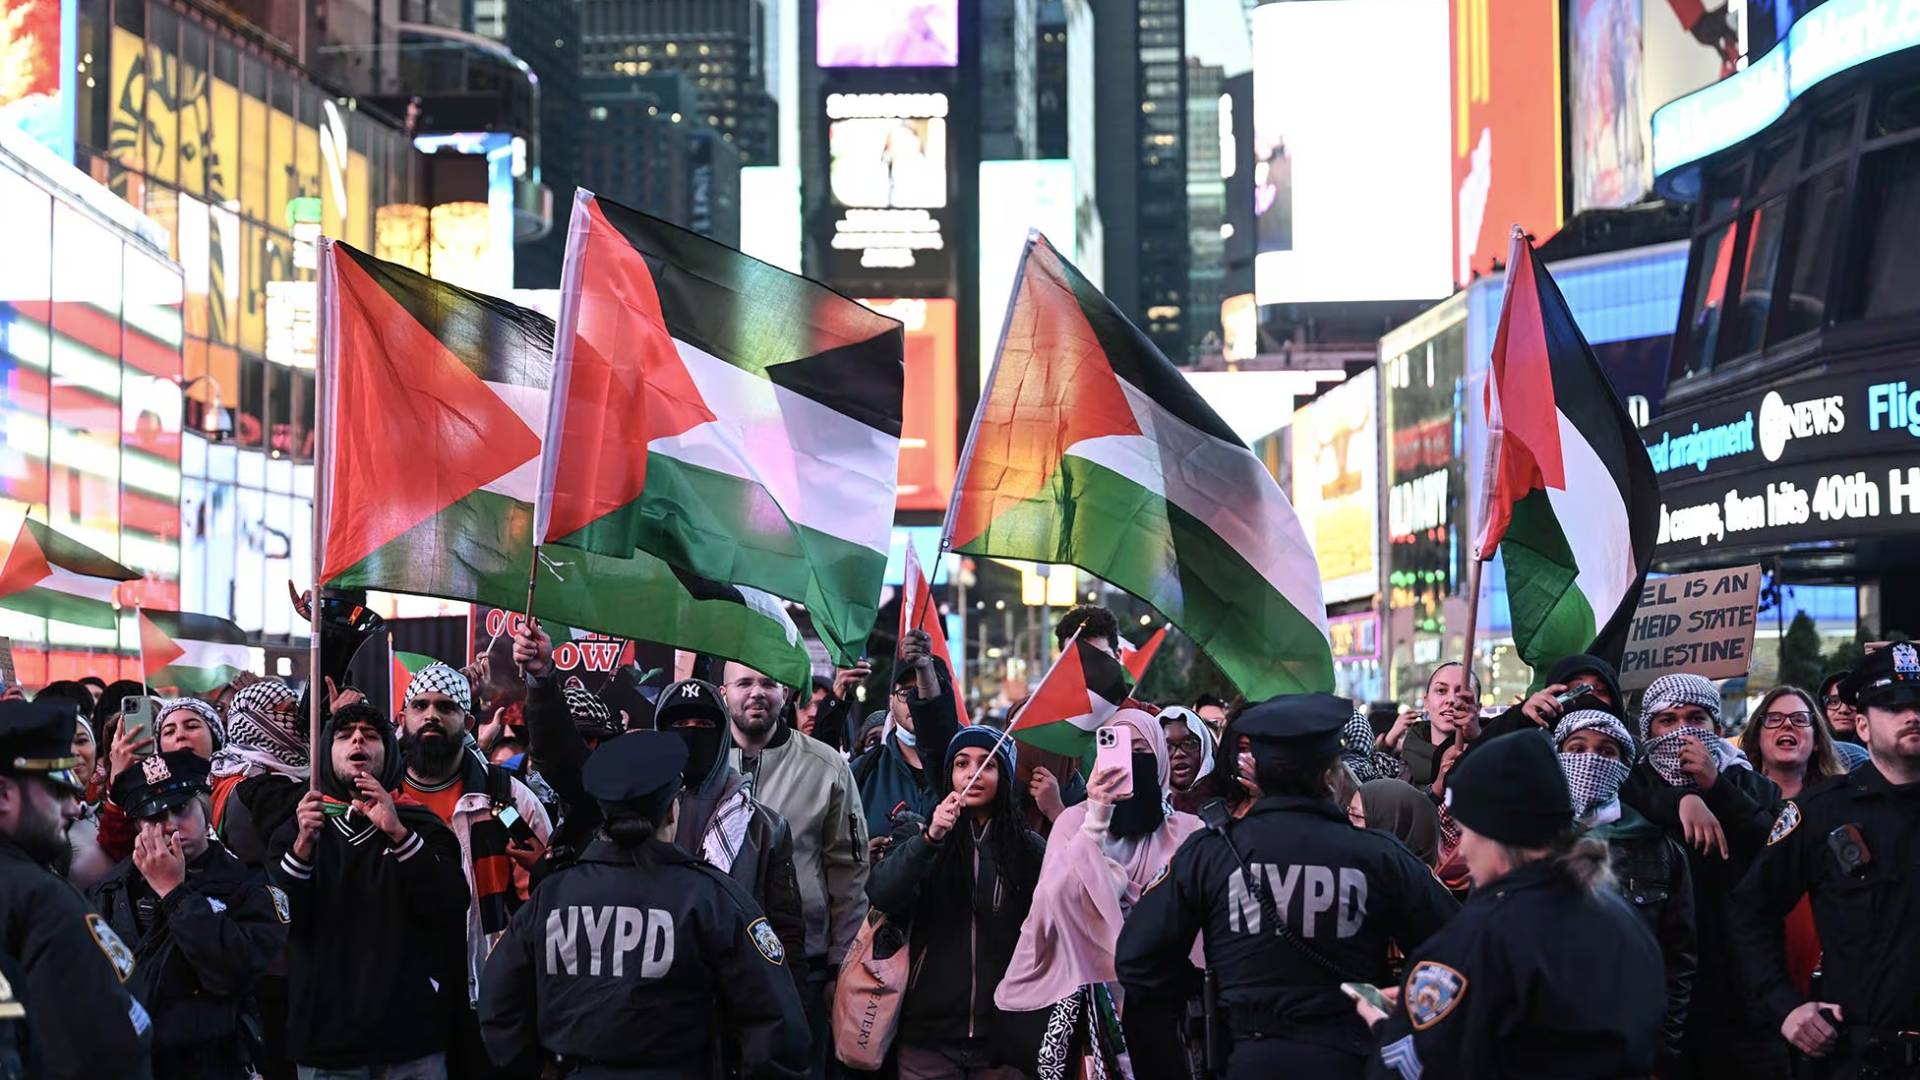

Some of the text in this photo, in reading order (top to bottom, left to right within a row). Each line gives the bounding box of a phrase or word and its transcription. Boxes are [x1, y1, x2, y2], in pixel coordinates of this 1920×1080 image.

[1783, 395, 1846, 440] NEWS
[1724, 489, 1766, 532] then
[1767, 481, 1810, 527] hits
[1812, 472, 1880, 521] 40th
[1683, 578, 1708, 598] IS
[1712, 572, 1749, 596] AN
[1687, 605, 1754, 633] STATE
[552, 641, 620, 672] OW
[1621, 637, 1745, 673] PALESTINE
[1228, 862, 1368, 939] NYPD
[545, 905, 675, 979] NYPD
